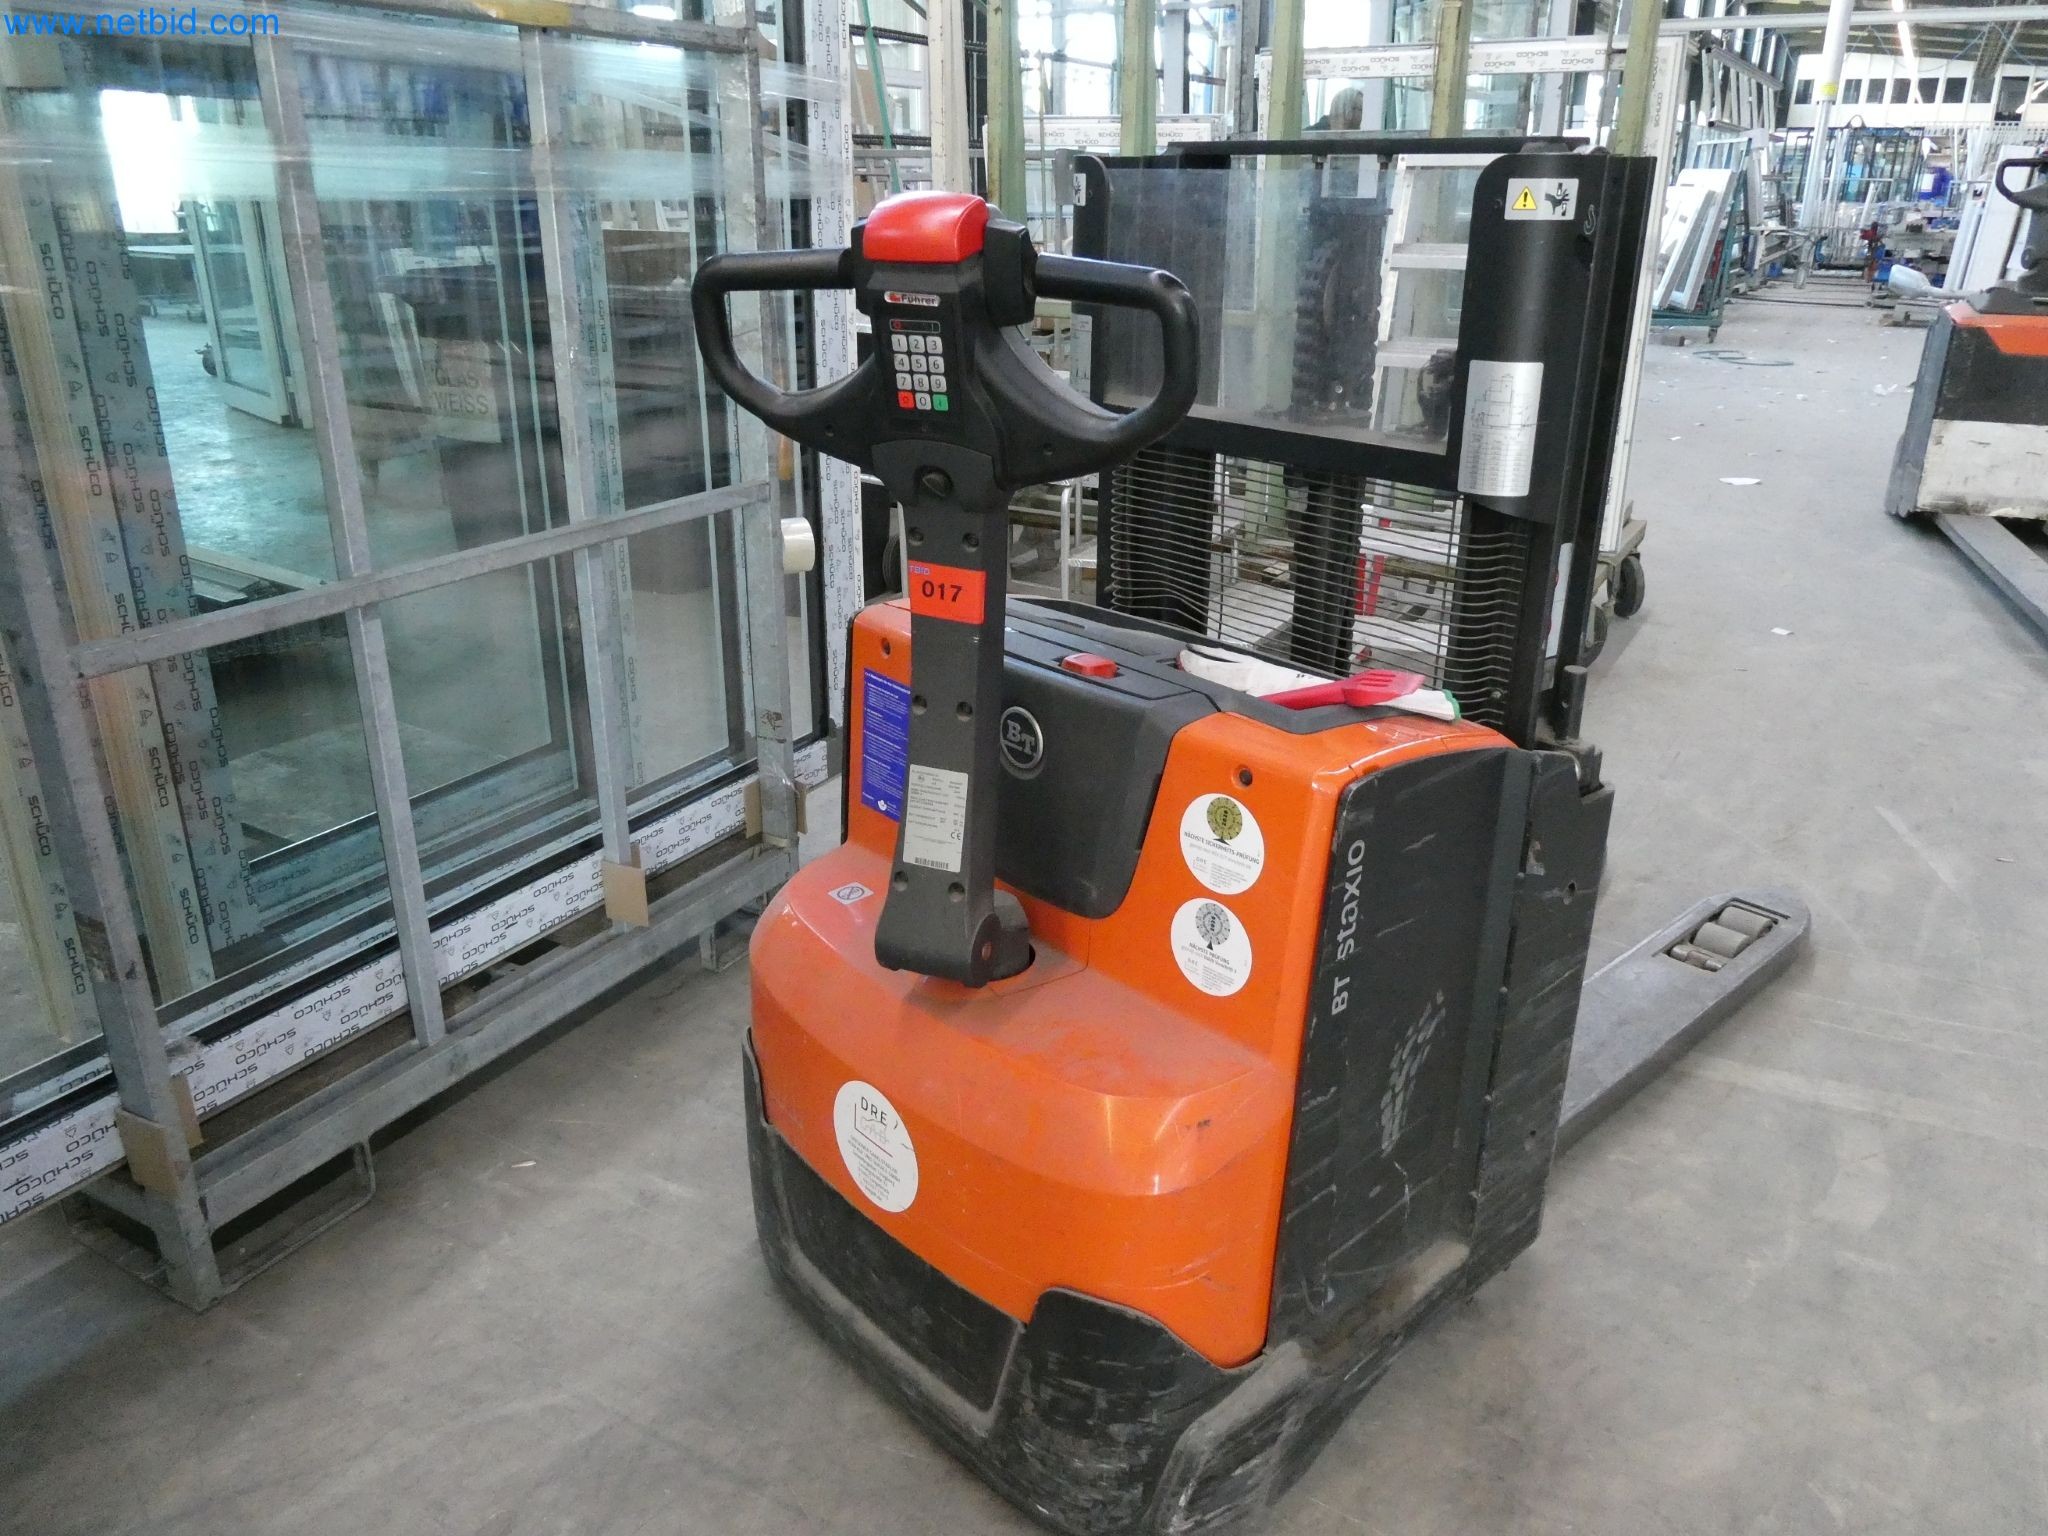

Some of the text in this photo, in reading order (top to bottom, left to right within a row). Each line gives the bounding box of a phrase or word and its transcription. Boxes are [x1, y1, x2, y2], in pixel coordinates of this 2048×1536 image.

[922, 580, 962, 602] 017
[1006, 720, 1036, 756] BT
[150, 746, 169, 808] SCHÜCO
[28, 795, 51, 856] SCHÜCO
[533, 872, 575, 898] SCHÜCO
[179, 887, 199, 945] SCHÜCO
[491, 904, 535, 932] SCHÜCO
[433, 925, 472, 950] SCHÜC
[462, 932, 507, 960] SCHÜCO
[64, 938, 85, 995] SCHÜCO
[294, 985, 351, 1020] SCHÜCO
[341, 991, 394, 1025] SCHÜCO
[1332, 977, 1350, 1016] BT
[235, 1028, 297, 1065] SCHÜCO
[194, 1064, 258, 1102] SCHÜCO
[861, 1096, 888, 1127] DRE
[66, 1121, 117, 1153] HÜCO
[16, 1150, 94, 1196] SCHÜCO
